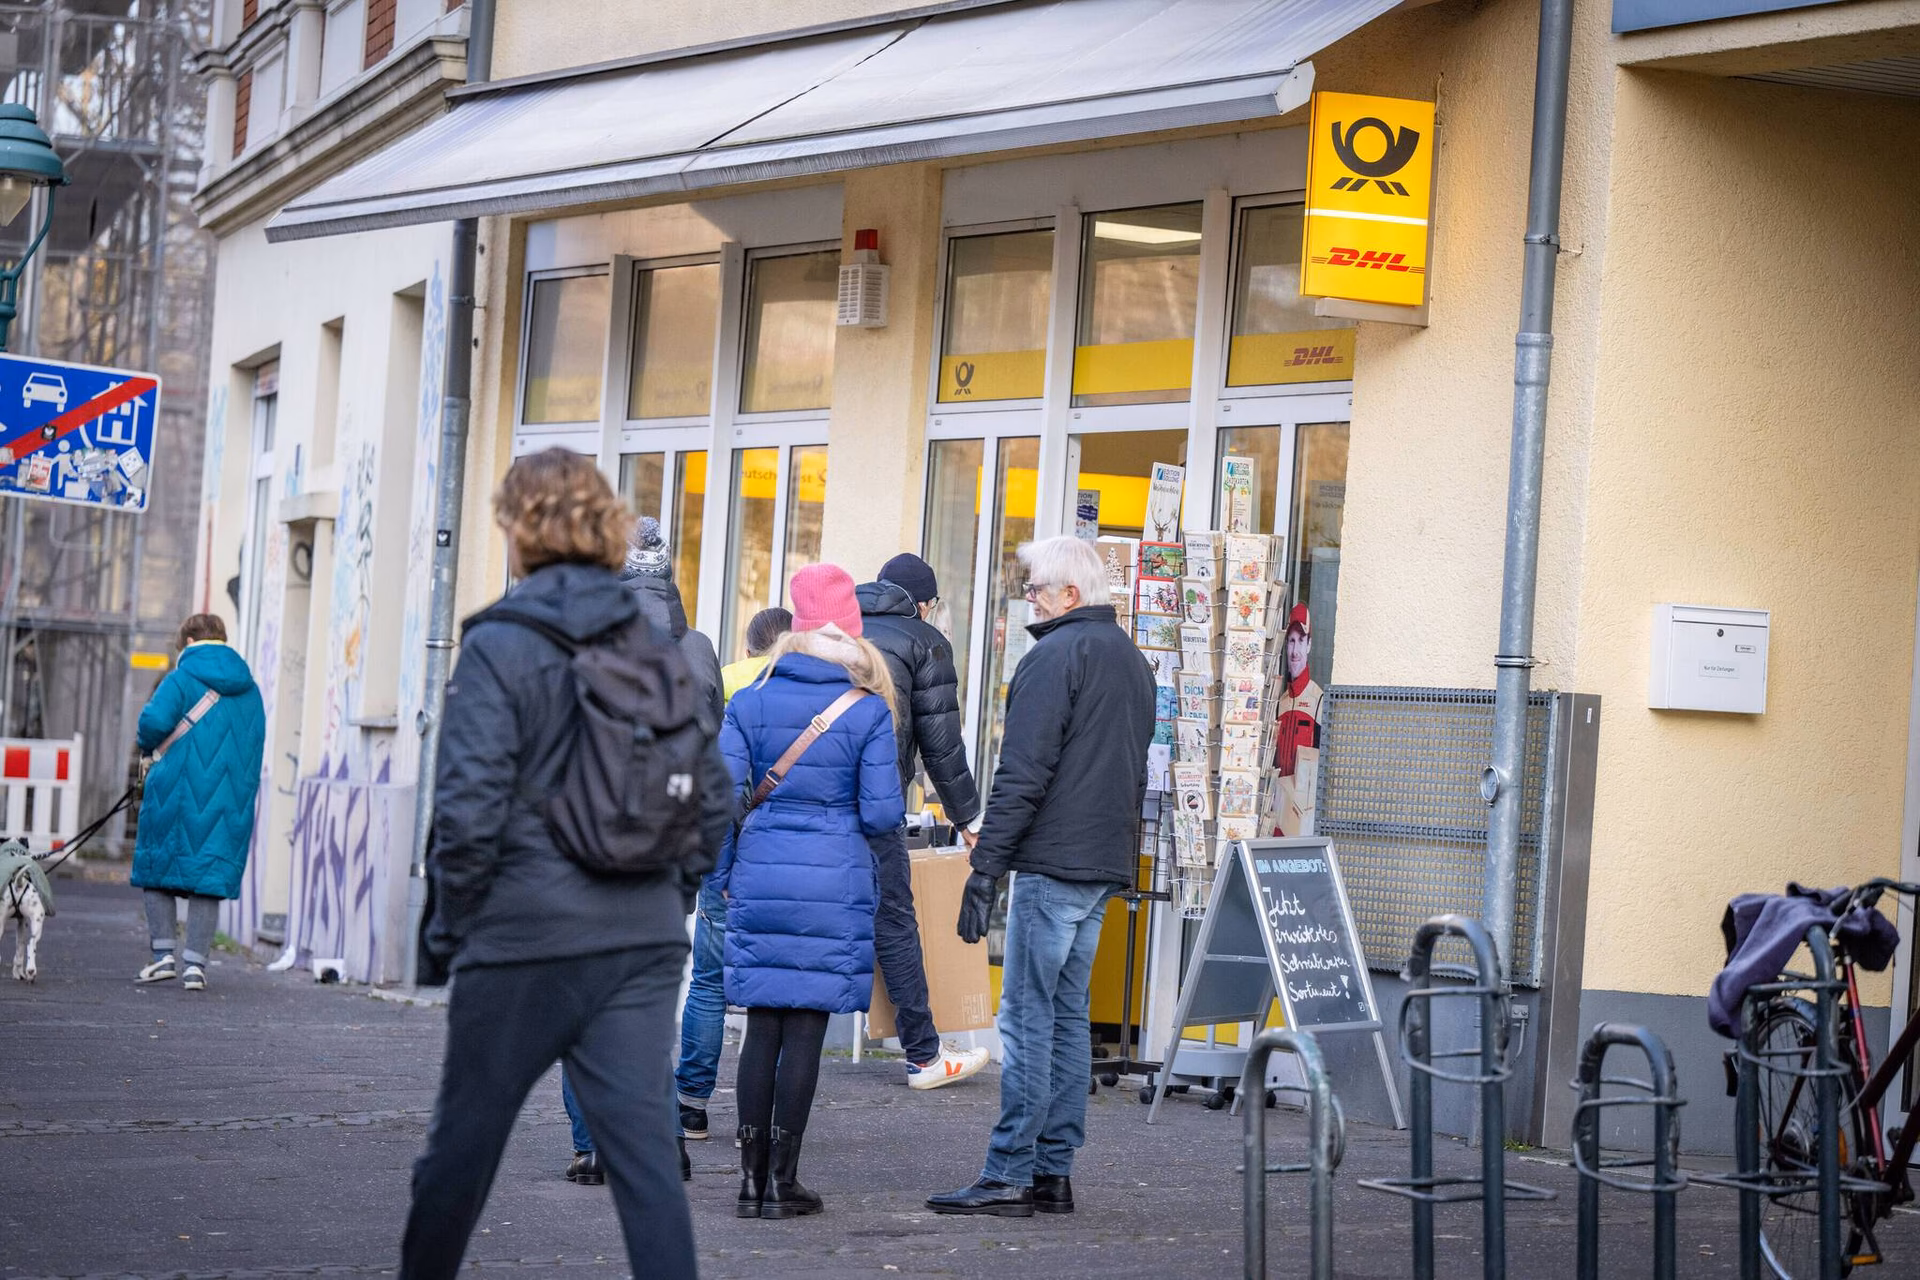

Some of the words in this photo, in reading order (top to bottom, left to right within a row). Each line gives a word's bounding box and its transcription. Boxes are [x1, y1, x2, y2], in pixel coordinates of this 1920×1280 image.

[1326, 246, 1411, 272] DHL
[1291, 345, 1336, 366] DHL
[1184, 685, 1204, 696] DICH
[1256, 859, 1271, 873] IM
[1272, 859, 1327, 873] ANGEBOT:
